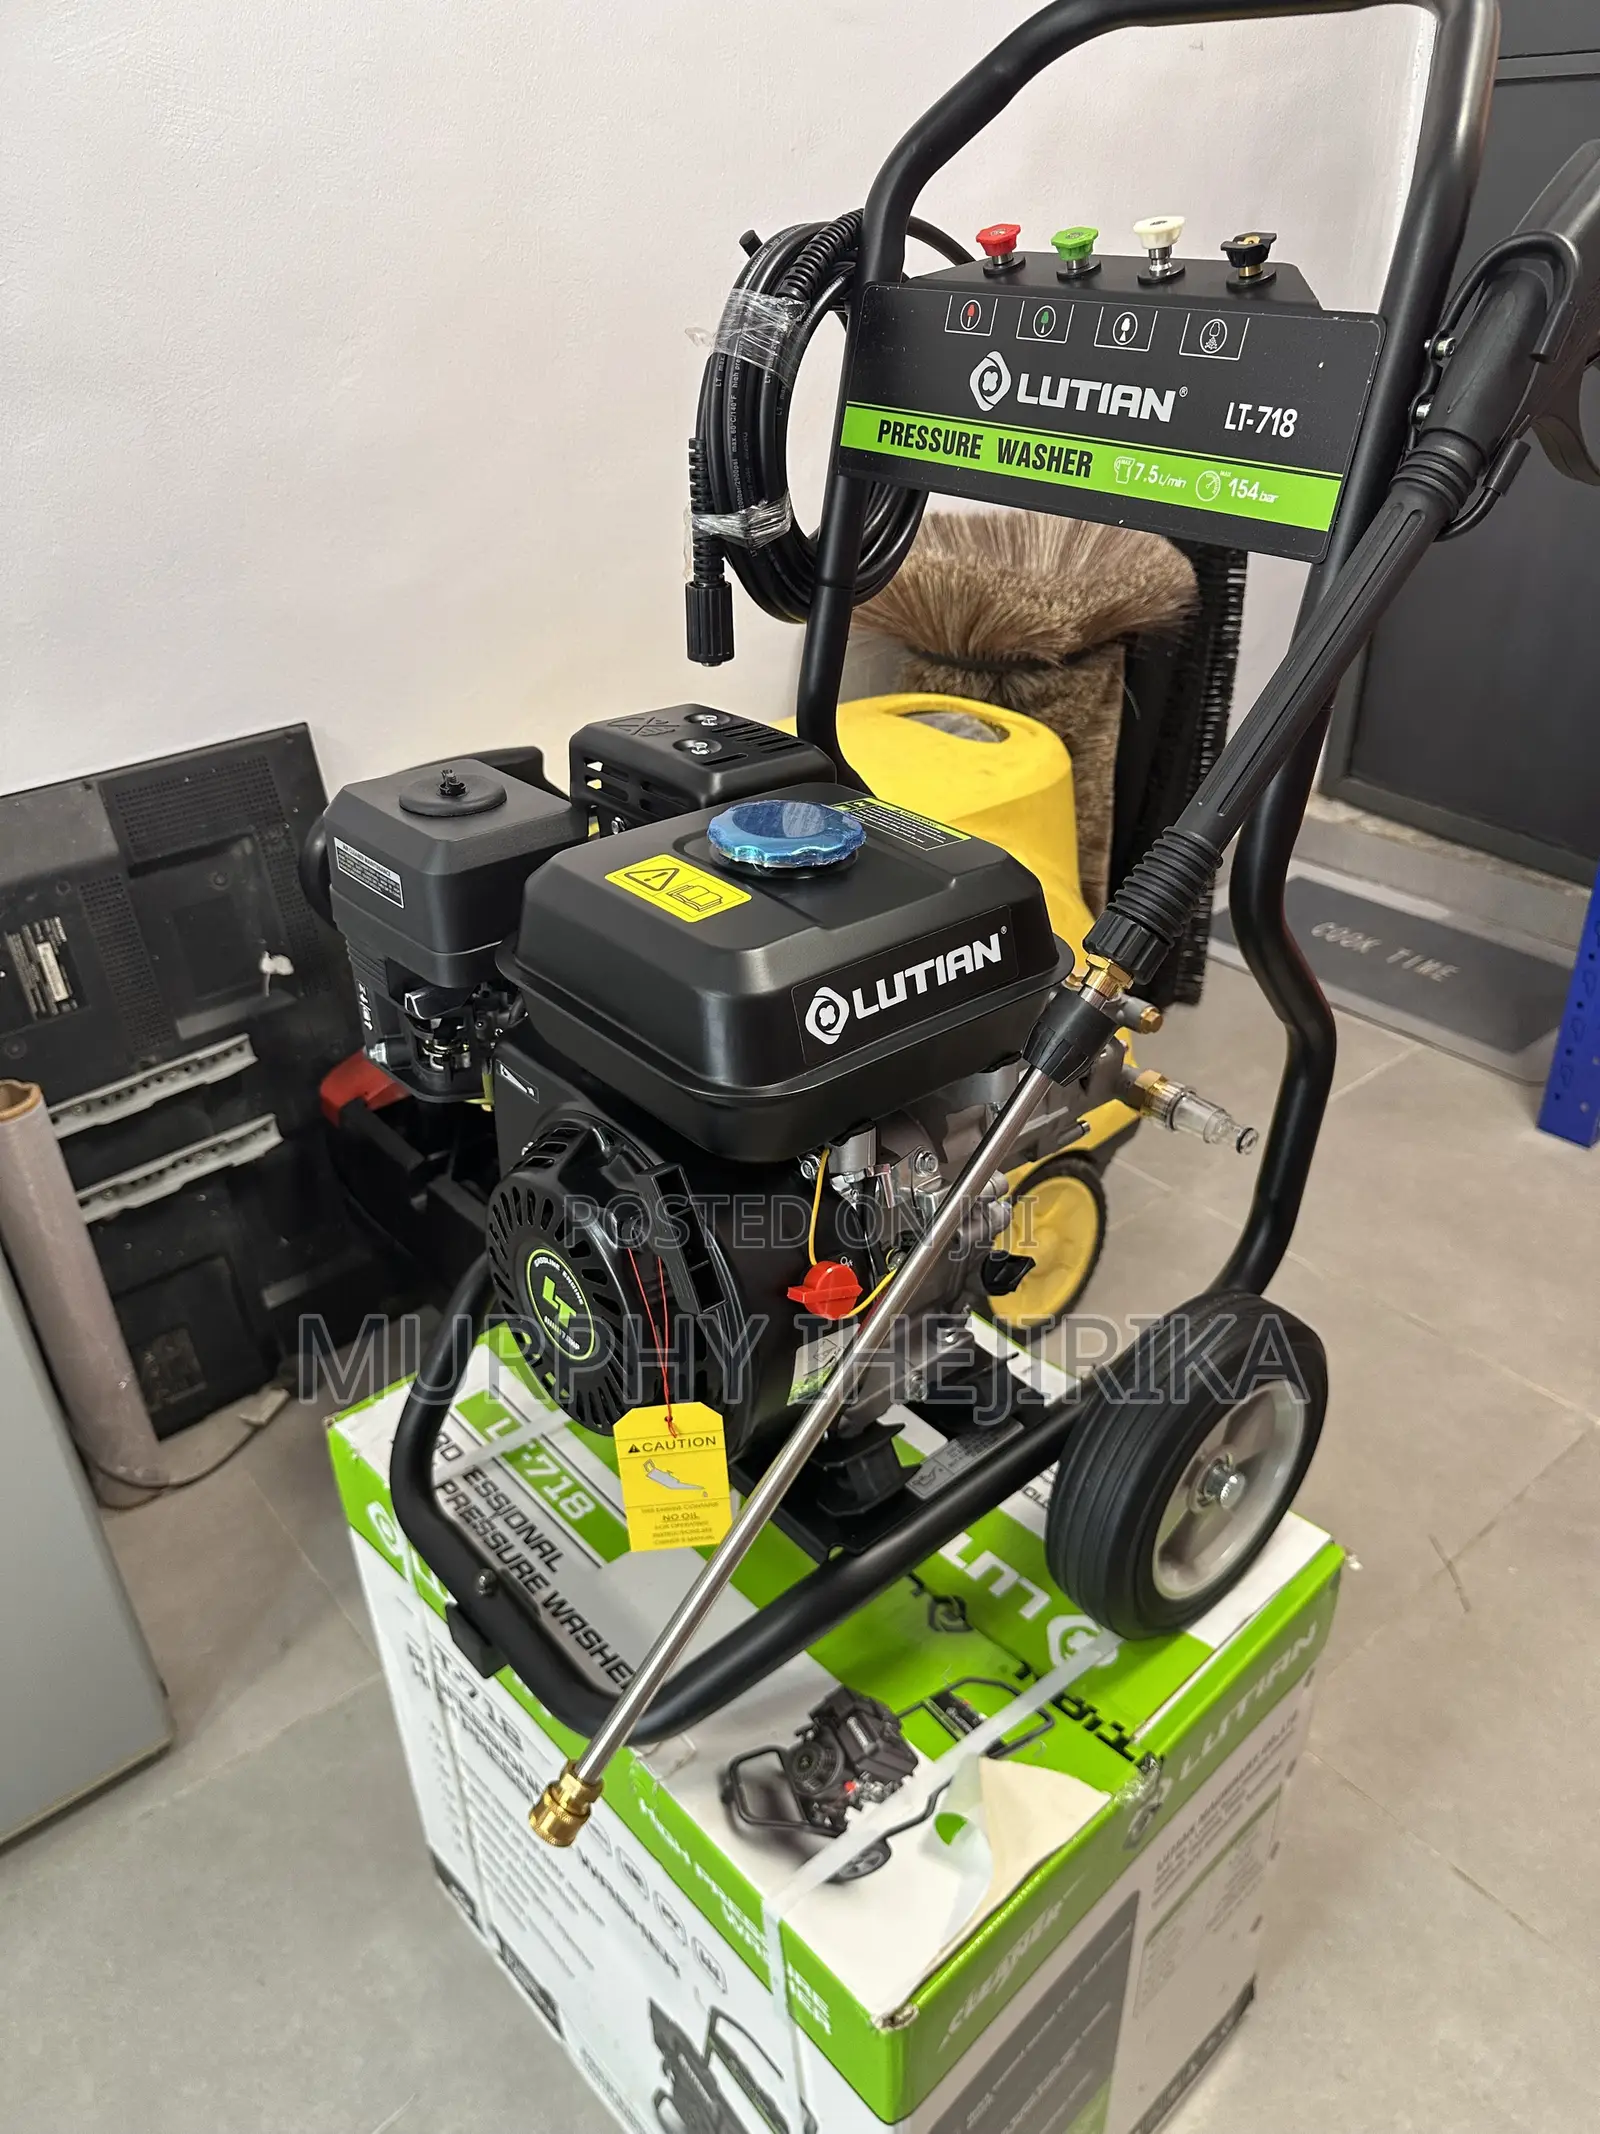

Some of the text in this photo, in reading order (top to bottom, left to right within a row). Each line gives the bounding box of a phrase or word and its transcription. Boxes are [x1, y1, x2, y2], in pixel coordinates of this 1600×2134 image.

[1223, 401, 1298, 438] LT-718
[876, 418, 1094, 479] PRESSURE WASHER
[1386, 948, 1460, 982] TIME
[543, 1275, 577, 1329] LT
[642, 1436, 717, 1453] CAUTION
[485, 1417, 597, 1520] L-718
[662, 1511, 700, 1522] NO OIL
[434, 1480, 552, 1594] PRESSURE
[540, 1588, 637, 1692] WASHE
